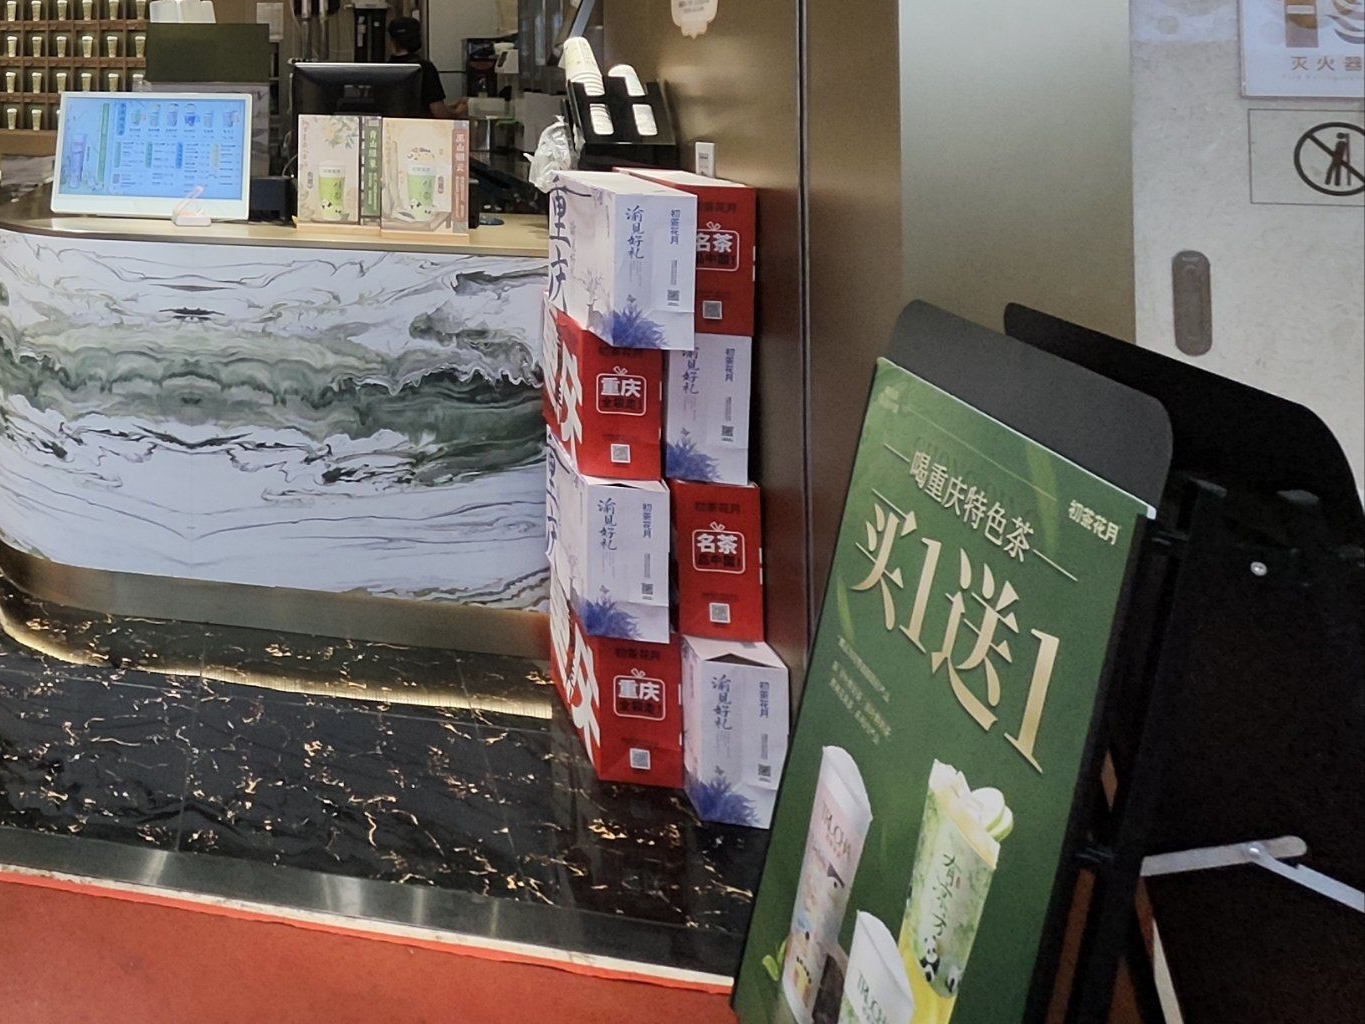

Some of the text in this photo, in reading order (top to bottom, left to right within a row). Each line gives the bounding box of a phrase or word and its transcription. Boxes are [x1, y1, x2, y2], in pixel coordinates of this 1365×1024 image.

[1290, 55, 1362, 72] 灭火器
[696, 232, 733, 253] 名茶
[600, 377, 642, 398] 重庆
[909, 450, 1035, 563] 喝重庆特色茶
[1068, 498, 1121, 546] 初茶花月
[696, 532, 739, 555] 名茶
[850, 487, 1061, 774] 买1送1
[618, 678, 661, 702] 重庆
